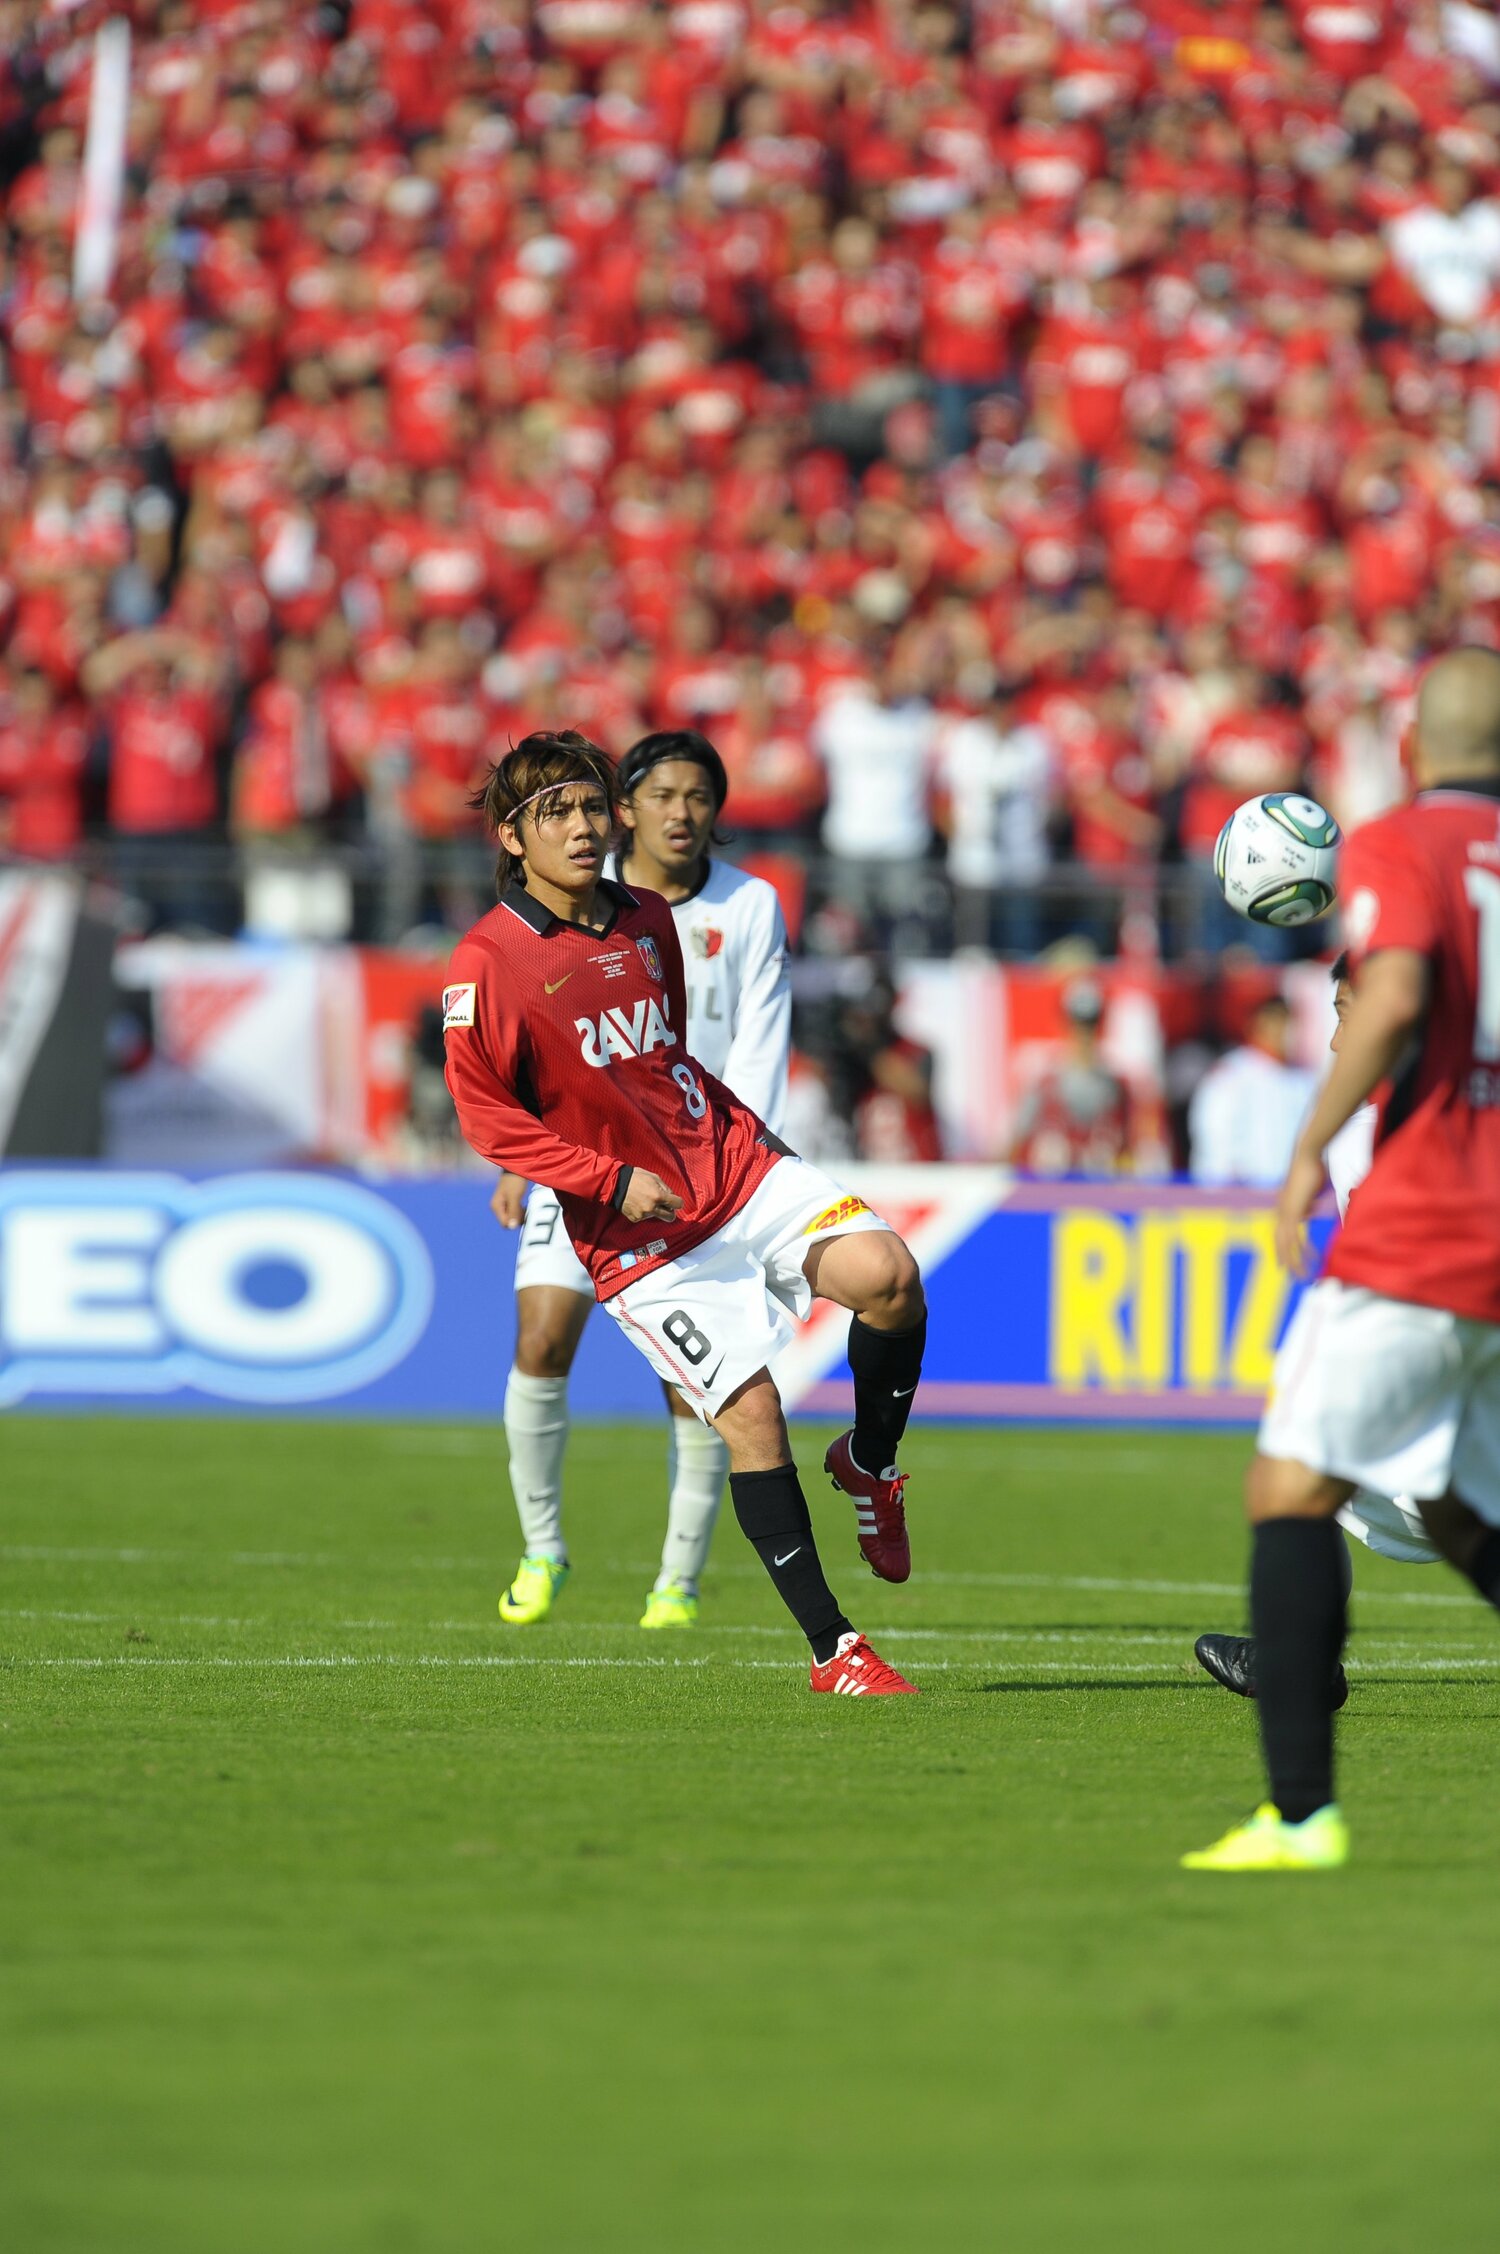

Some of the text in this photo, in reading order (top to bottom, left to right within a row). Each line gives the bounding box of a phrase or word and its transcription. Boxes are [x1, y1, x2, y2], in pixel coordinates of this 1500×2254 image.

[447, 1014, 470, 1022] FINAL
[672, 1063, 707, 1119] 8
[1055, 1208, 1284, 1393] RITZ
[662, 1309, 712, 1366] 8
